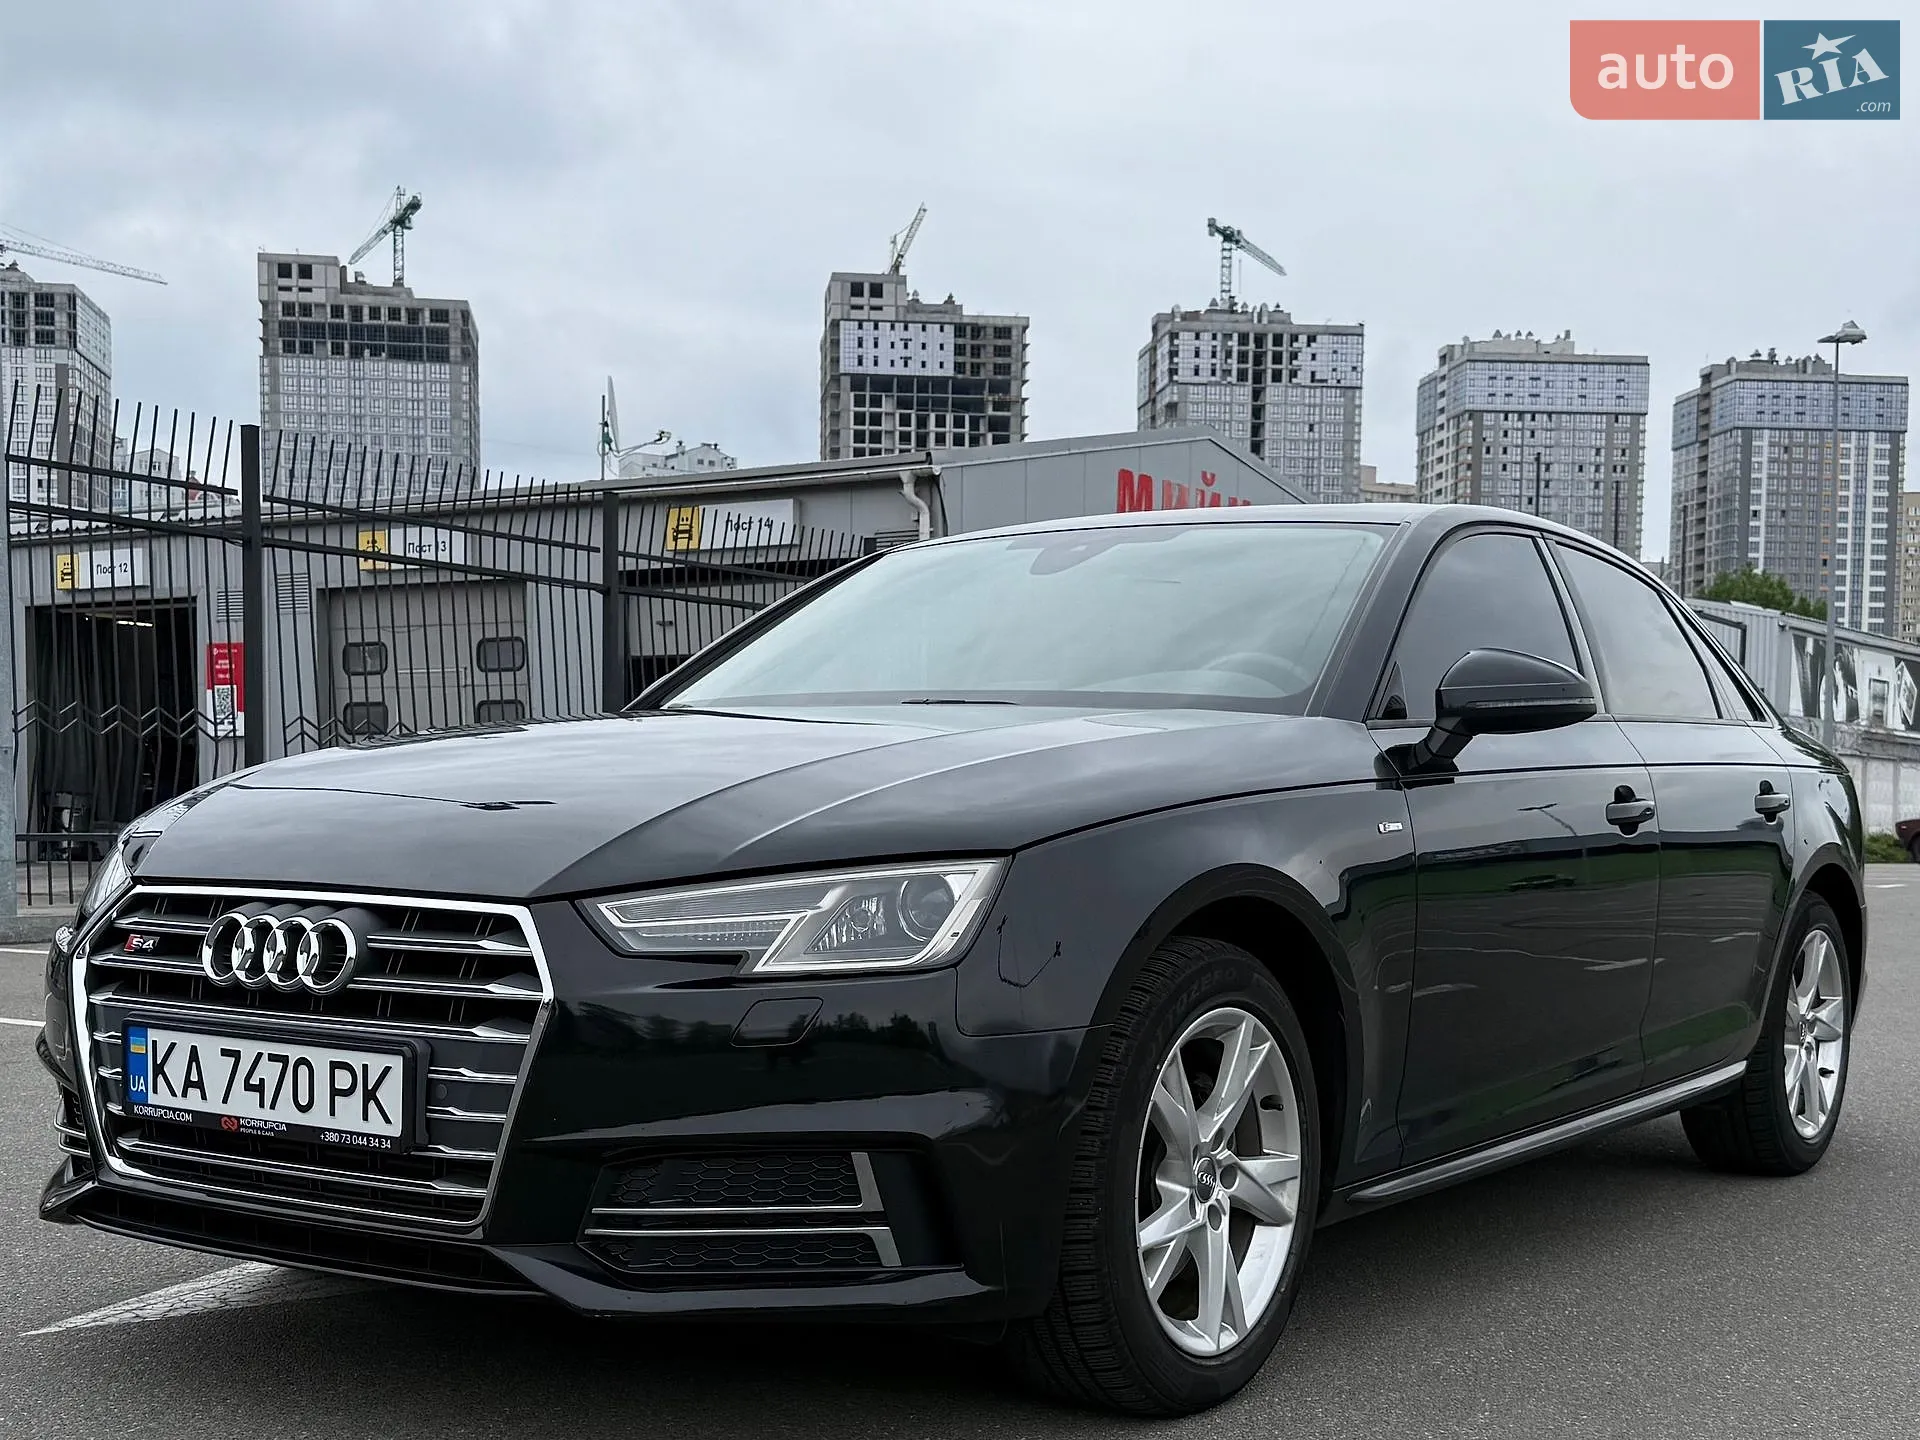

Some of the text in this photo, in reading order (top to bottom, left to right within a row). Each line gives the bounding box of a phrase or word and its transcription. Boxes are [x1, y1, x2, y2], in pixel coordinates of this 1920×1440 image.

[1117, 468, 1251, 513] МИЙ
[119, 562, 128, 573] 12
[128, 936, 157, 951] S4
[130, 1074, 146, 1093] UA
[151, 1039, 393, 1125] KA 7470 PK
[133, 1104, 193, 1122] KORRUPCIA.COM
[240, 1117, 287, 1132] KORRUPCIA
[320, 1131, 391, 1149] +380 73 044 34 34
